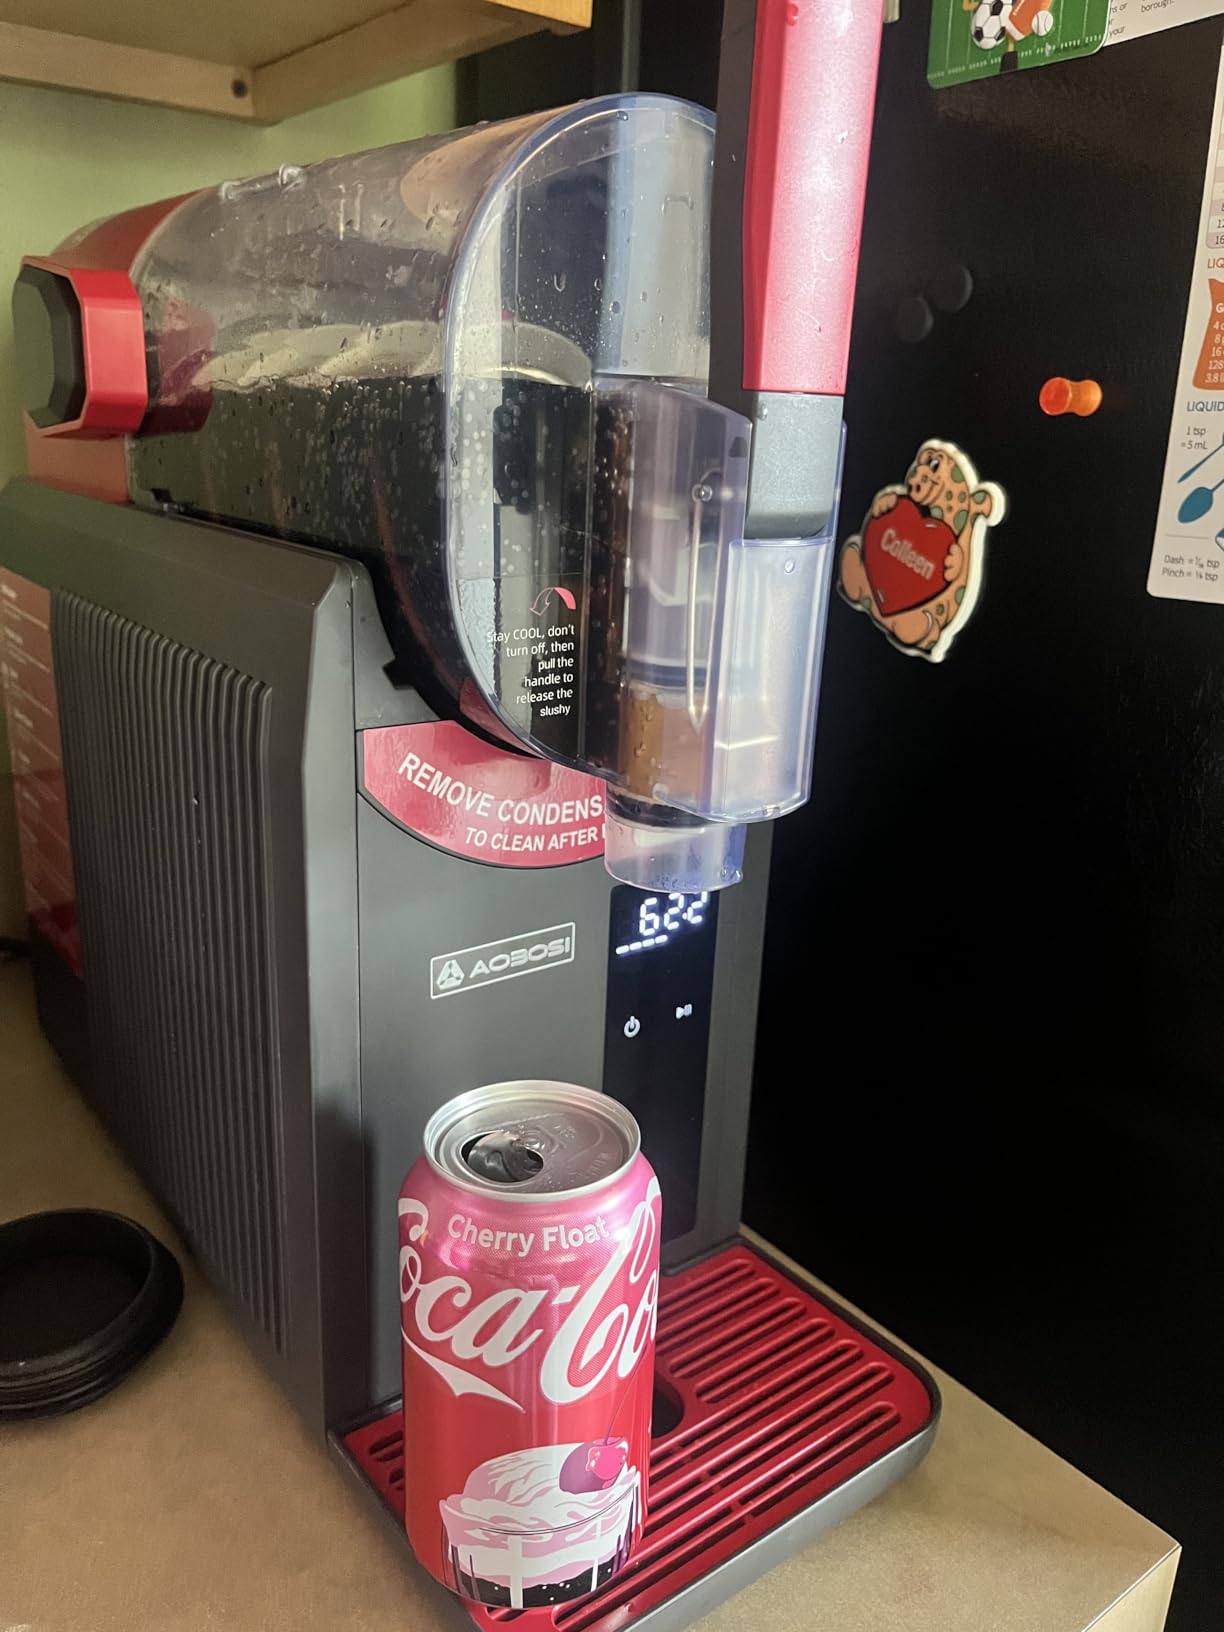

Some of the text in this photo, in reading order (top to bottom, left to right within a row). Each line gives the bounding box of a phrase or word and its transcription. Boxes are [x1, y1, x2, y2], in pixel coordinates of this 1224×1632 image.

[880, 527, 936, 581] Colleen
[486, 623, 575, 644] Stay COOL, don't
[506, 641, 574, 658] turn off, then
[538, 656, 574, 673] pull the
[524, 673, 574, 688] handle to
[516, 688, 573, 704] release the
[540, 704, 571, 717] slushy
[398, 751, 606, 826] REMOVE CONDENS
[465, 827, 487, 848] TO
[491, 832, 544, 852] CLEAN
[547, 826, 598, 851] AFTER
[469, 936, 571, 979] AOBOSI
[448, 1214, 610, 1257] Cherry Float
